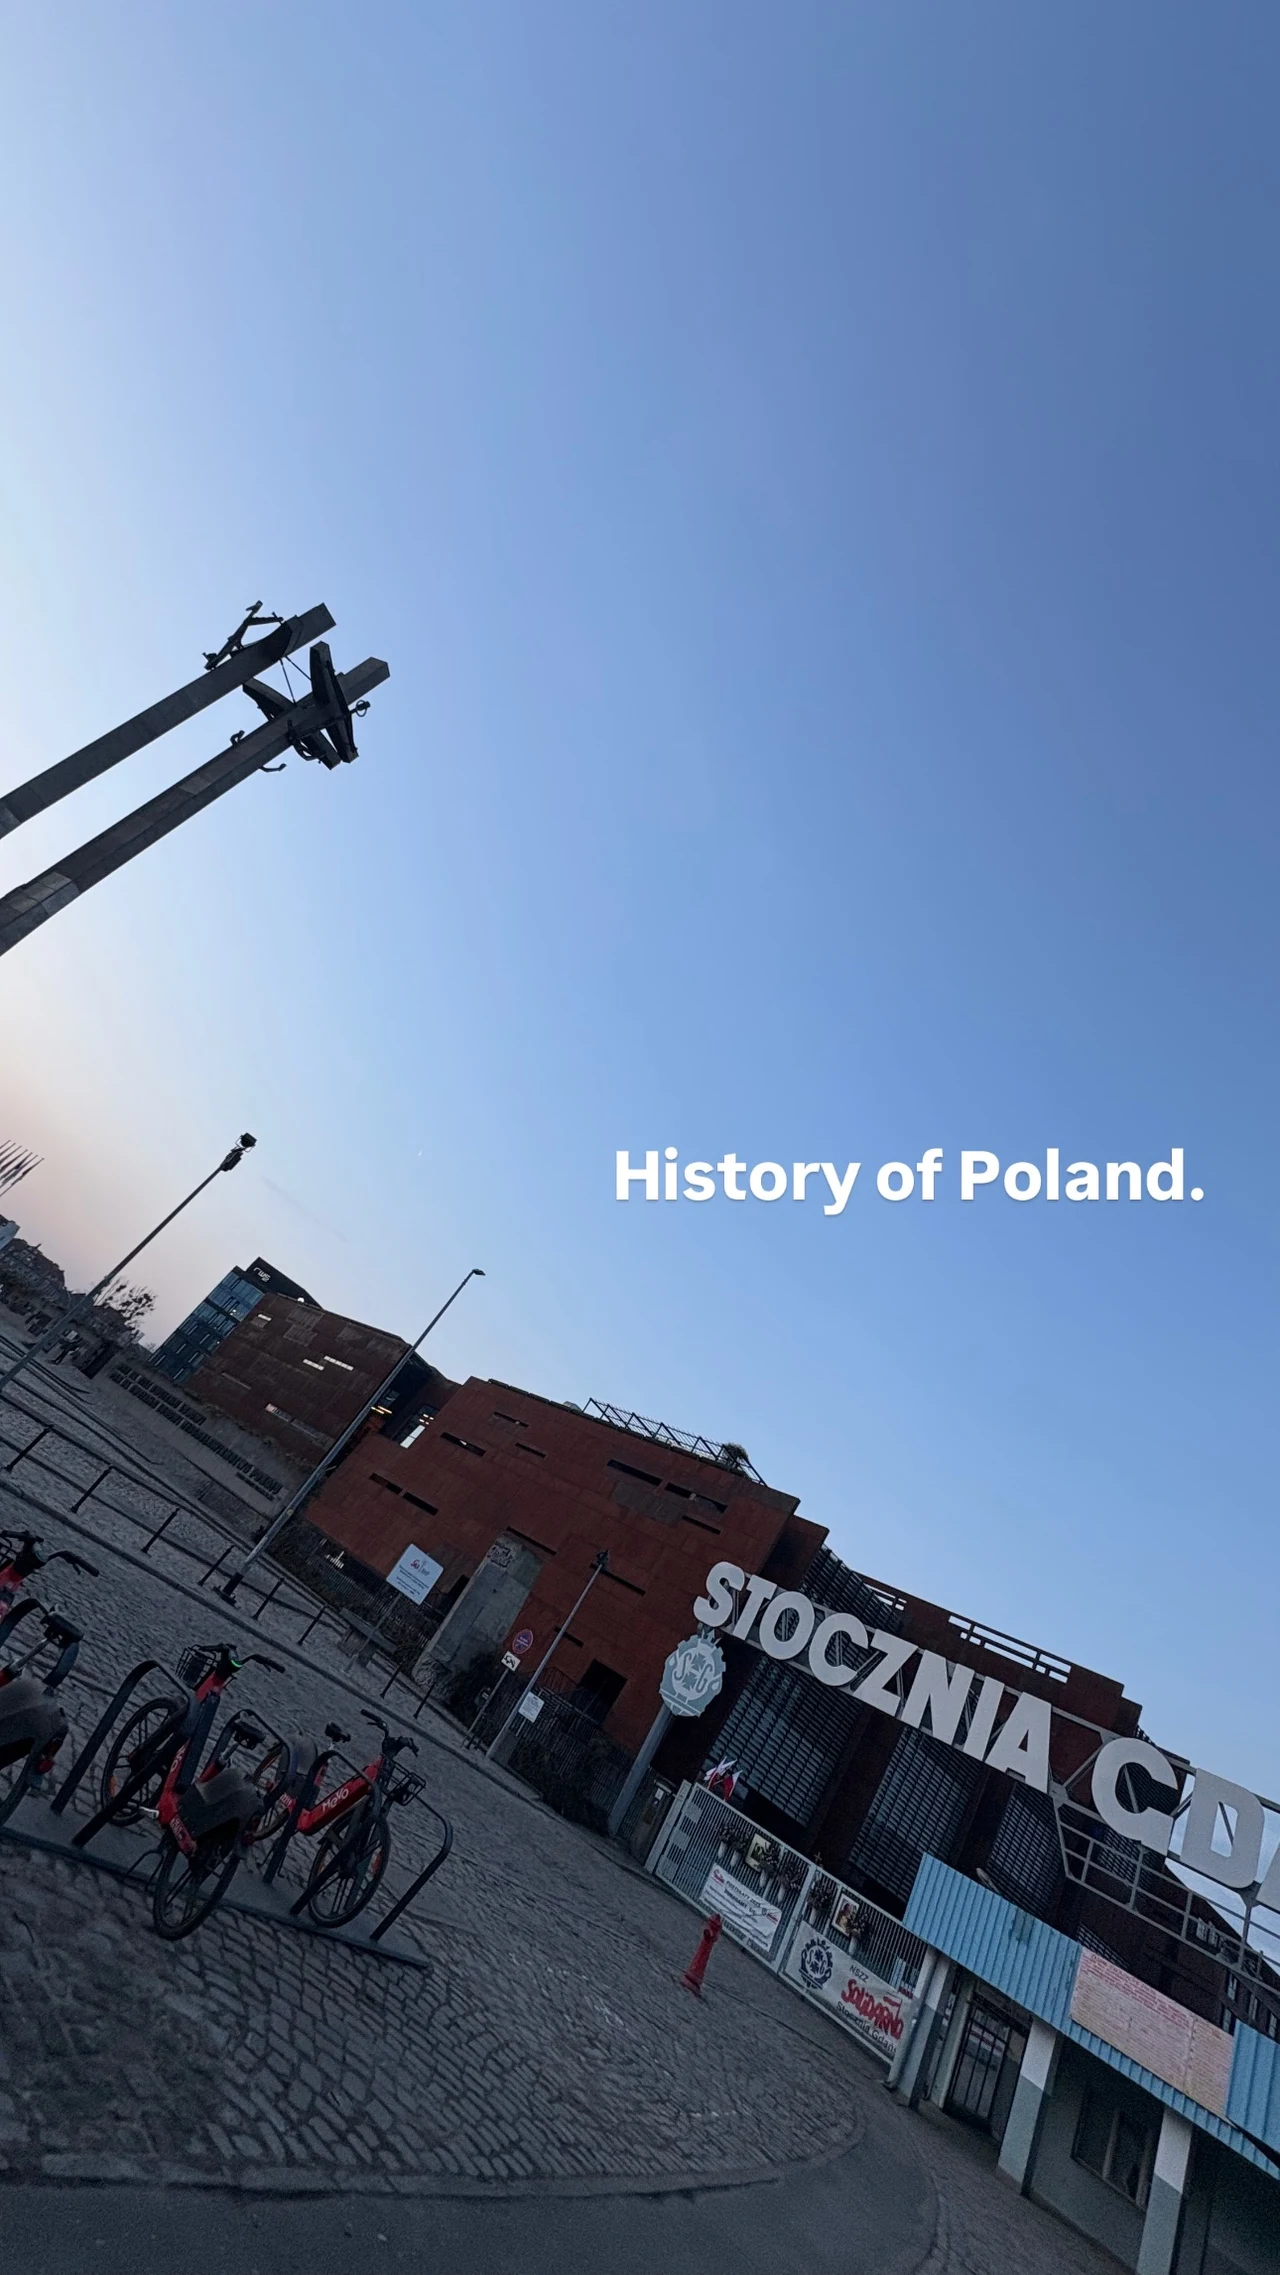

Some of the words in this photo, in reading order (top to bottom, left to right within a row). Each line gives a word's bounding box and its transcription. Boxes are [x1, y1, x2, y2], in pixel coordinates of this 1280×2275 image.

[692, 1560, 1053, 1795] STOCZNIA
[849, 1964, 869, 1984] NSZZ
[835, 2001, 871, 2032] Stocznia
